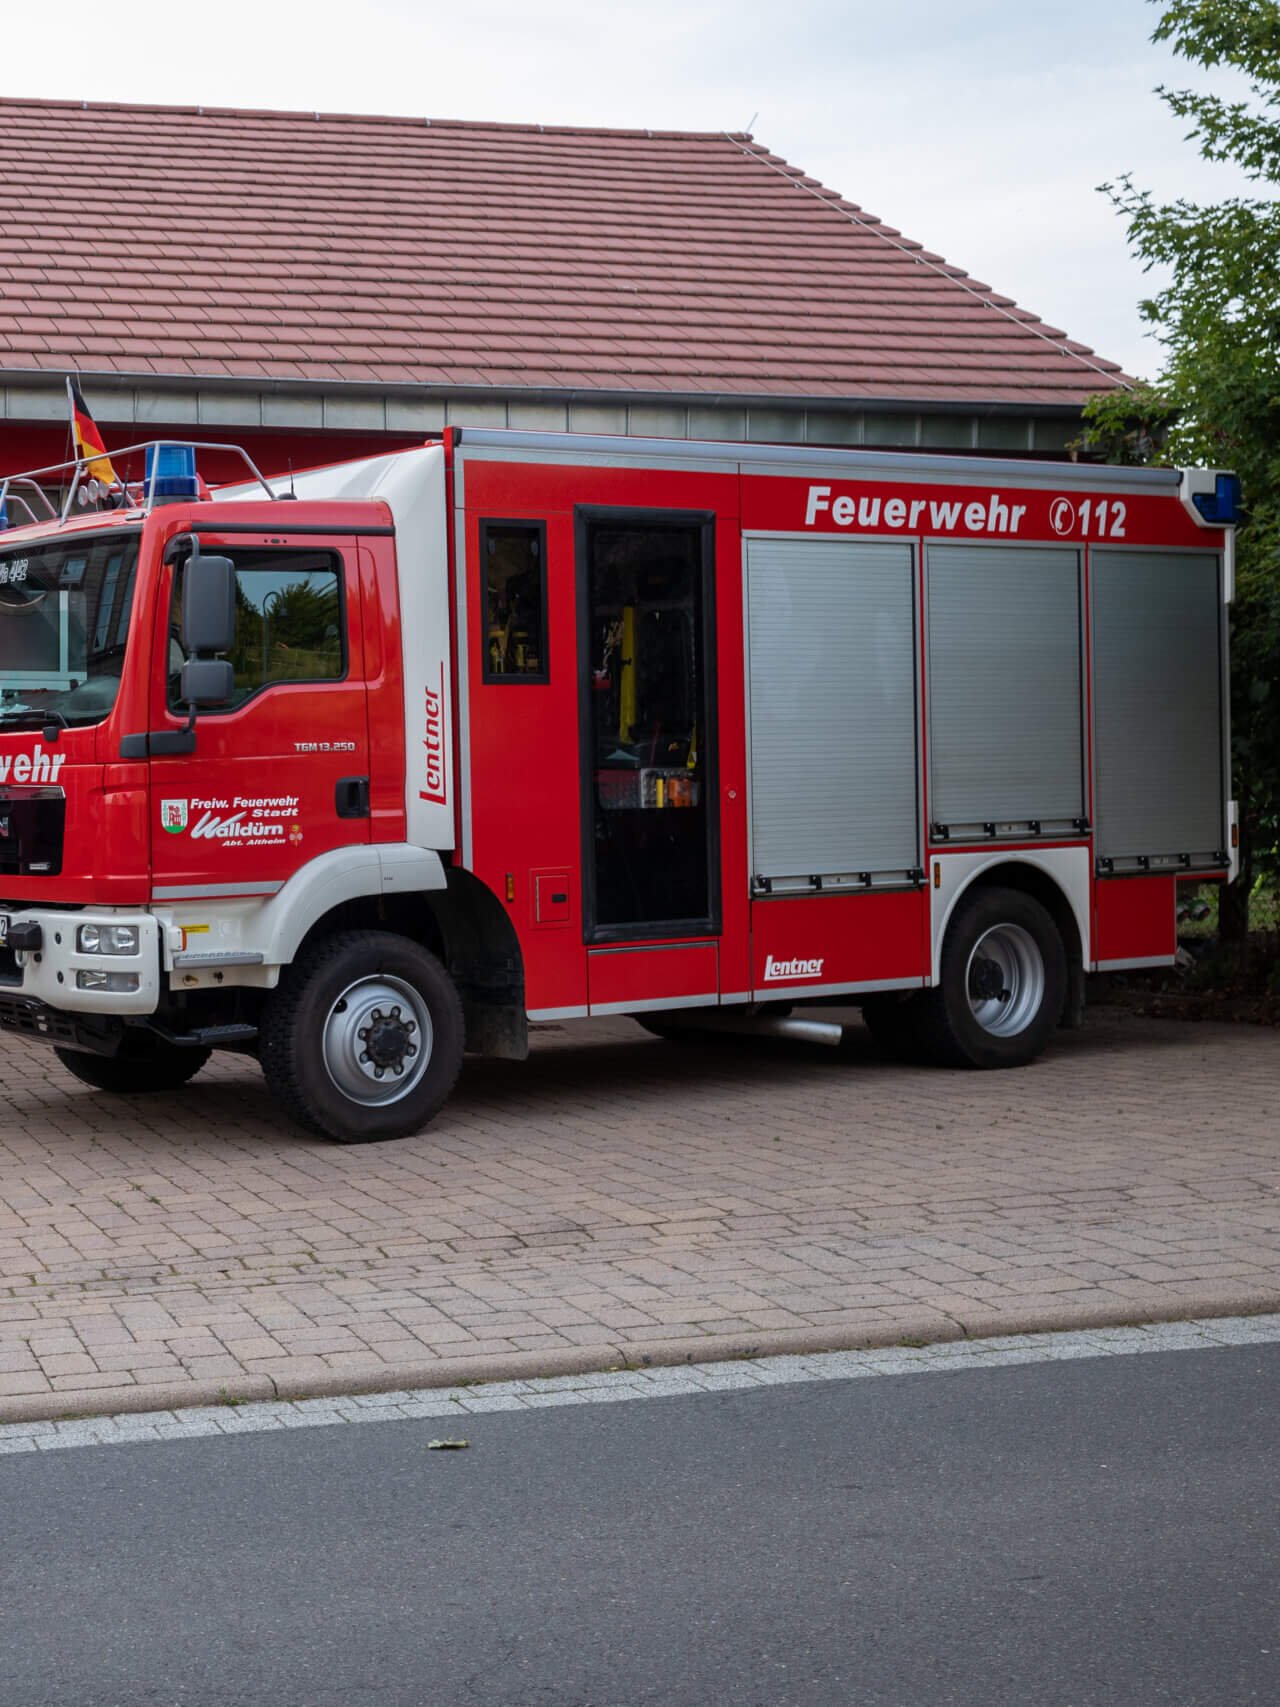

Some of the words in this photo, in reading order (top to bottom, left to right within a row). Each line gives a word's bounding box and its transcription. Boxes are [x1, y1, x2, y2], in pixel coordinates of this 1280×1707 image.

[805, 486, 1027, 534] Feuerwehr
[1077, 499, 1127, 537] 112
[294, 742, 317, 752] TGM
[319, 742, 356, 752] 13.250
[190, 798, 229, 809] Freiw.
[233, 795, 299, 808] Feuerwehr
[252, 808, 299, 818] Stadt
[190, 810, 284, 839] Walldürn
[222, 839, 244, 847] Abt.
[246, 838, 286, 846] Altheim
[764, 954, 824, 981] Lentner
